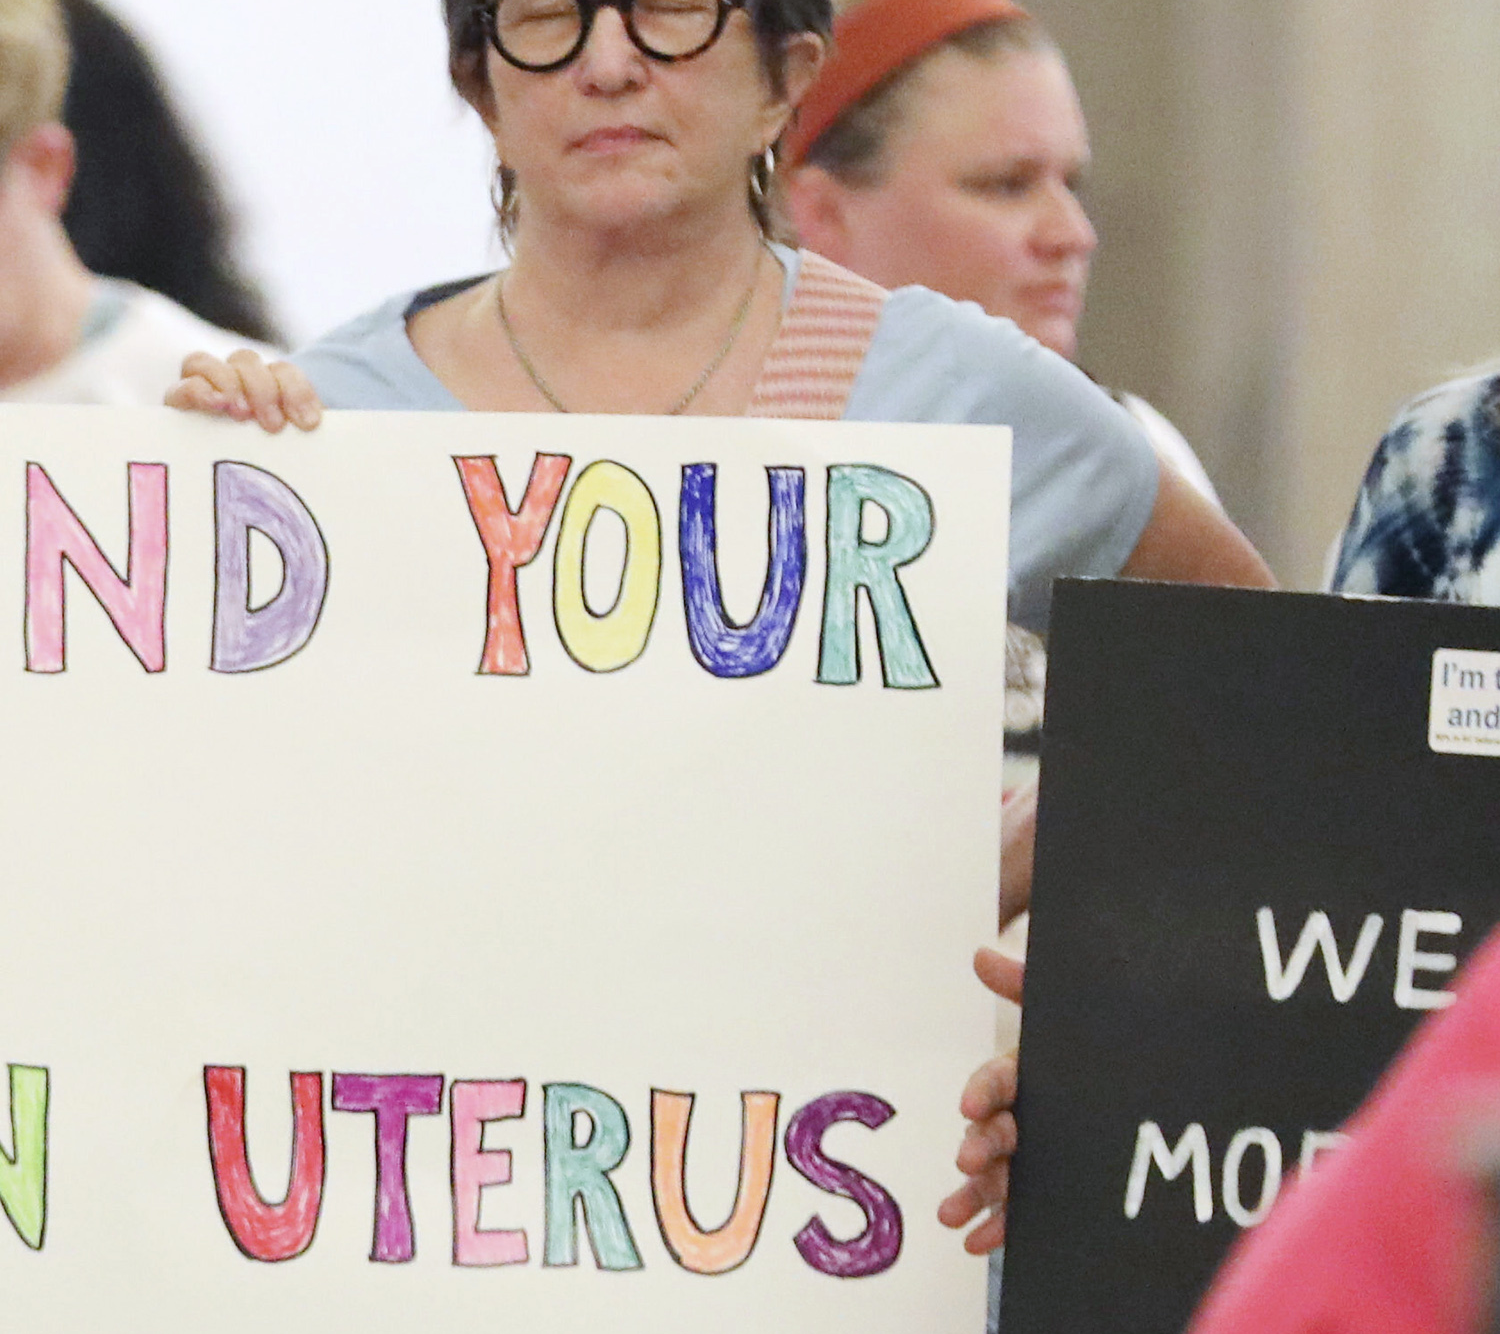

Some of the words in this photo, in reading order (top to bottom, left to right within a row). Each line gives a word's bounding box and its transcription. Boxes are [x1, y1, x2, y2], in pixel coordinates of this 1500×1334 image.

[450, 451, 942, 688] YOUR
[1442, 662, 1485, 690] I'm
[1447, 704, 1500, 729] and
[1256, 905, 1464, 1011] WE
[202, 1062, 906, 1278] UTERUS
